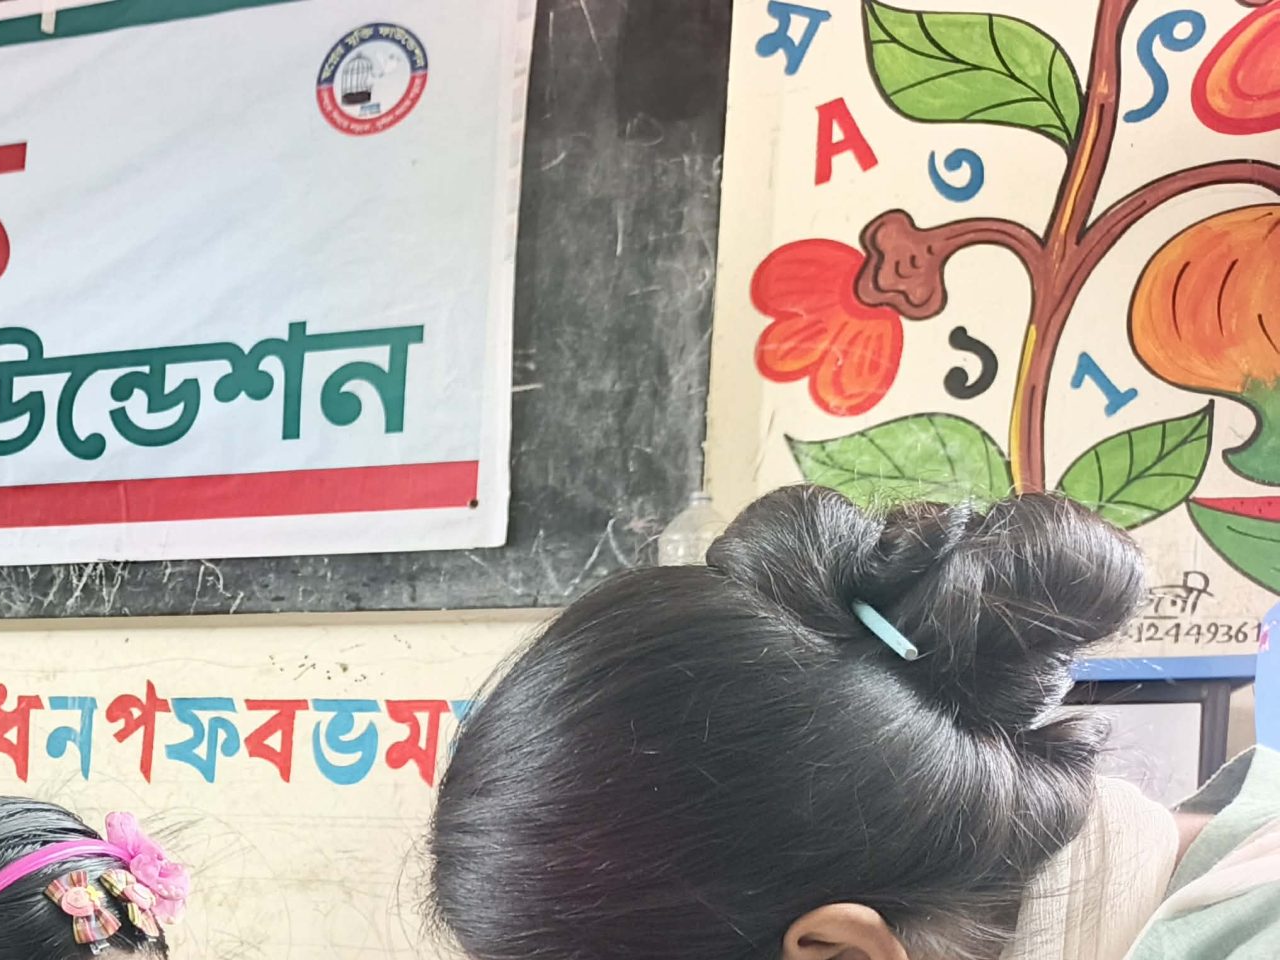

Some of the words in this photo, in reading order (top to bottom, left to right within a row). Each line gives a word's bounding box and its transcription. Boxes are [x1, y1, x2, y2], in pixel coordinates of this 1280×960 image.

[814, 97, 879, 187] A
[1071, 351, 1138, 418] 1
[1130, 621, 1263, 645] 12449361
[46, 696, 97, 781] ন
[105, 679, 171, 784] প
[165, 697, 241, 784] ফ
[244, 699, 309, 784] ব
[312, 699, 381, 786] ভ
[385, 699, 451, 787] ম
